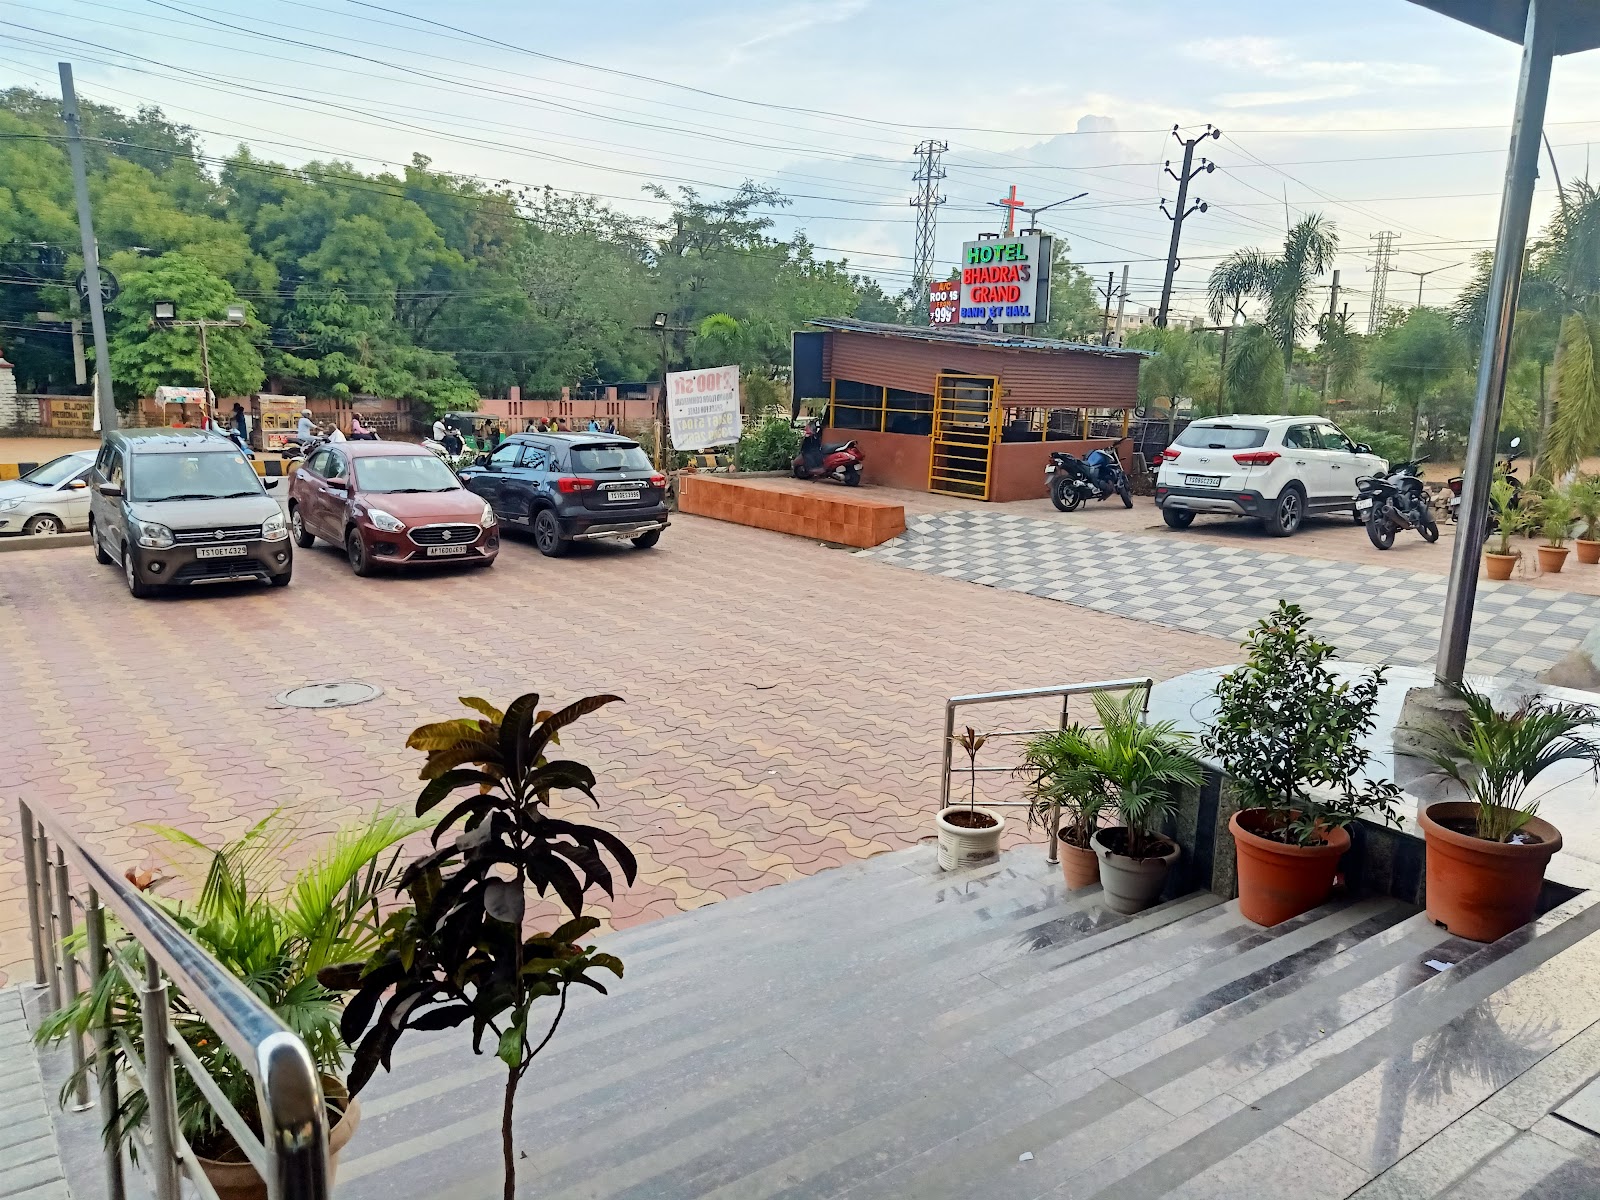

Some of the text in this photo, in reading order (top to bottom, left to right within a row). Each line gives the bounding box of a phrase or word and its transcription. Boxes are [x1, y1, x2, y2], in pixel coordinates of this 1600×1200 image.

[967, 244, 1028, 264] HOTEL
[963, 264, 1030, 285] BHADRA'S
[970, 286, 1020, 303] GRAND
[1006, 305, 1031, 317] HALL
